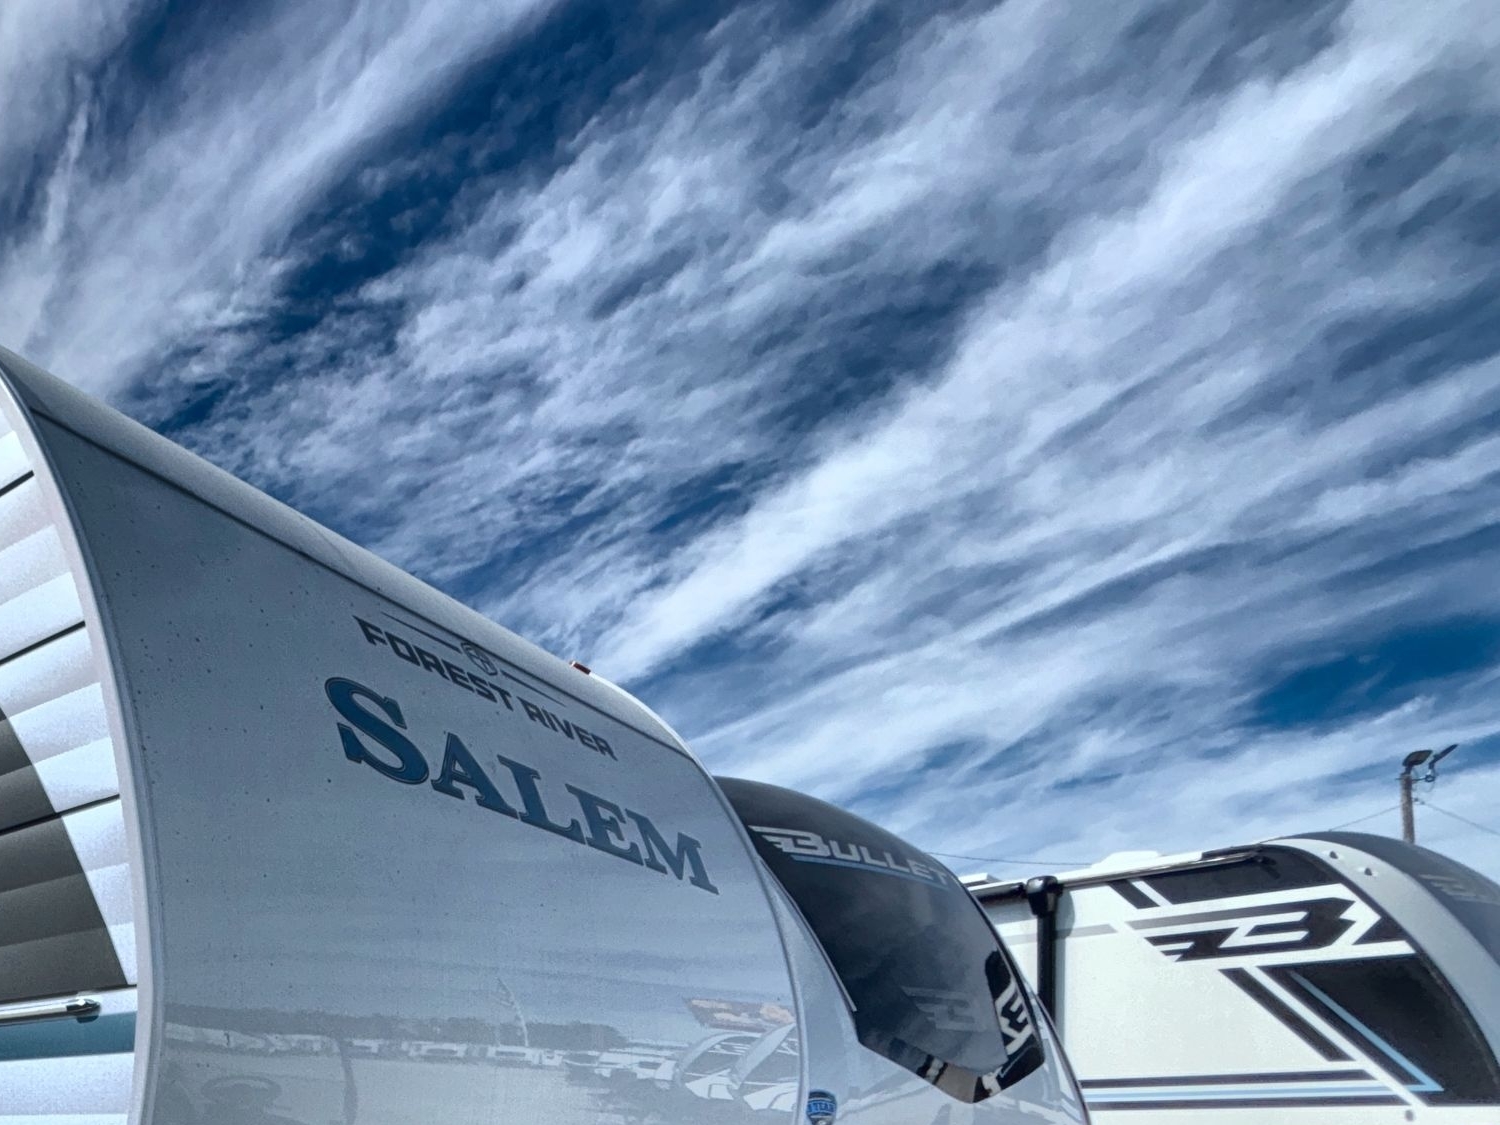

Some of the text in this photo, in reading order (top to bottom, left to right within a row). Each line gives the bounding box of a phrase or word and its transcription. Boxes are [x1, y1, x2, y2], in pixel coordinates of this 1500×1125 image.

[352, 615, 514, 711] FOREST
[516, 696, 618, 760] RIVER
[324, 677, 719, 895] SALEM
